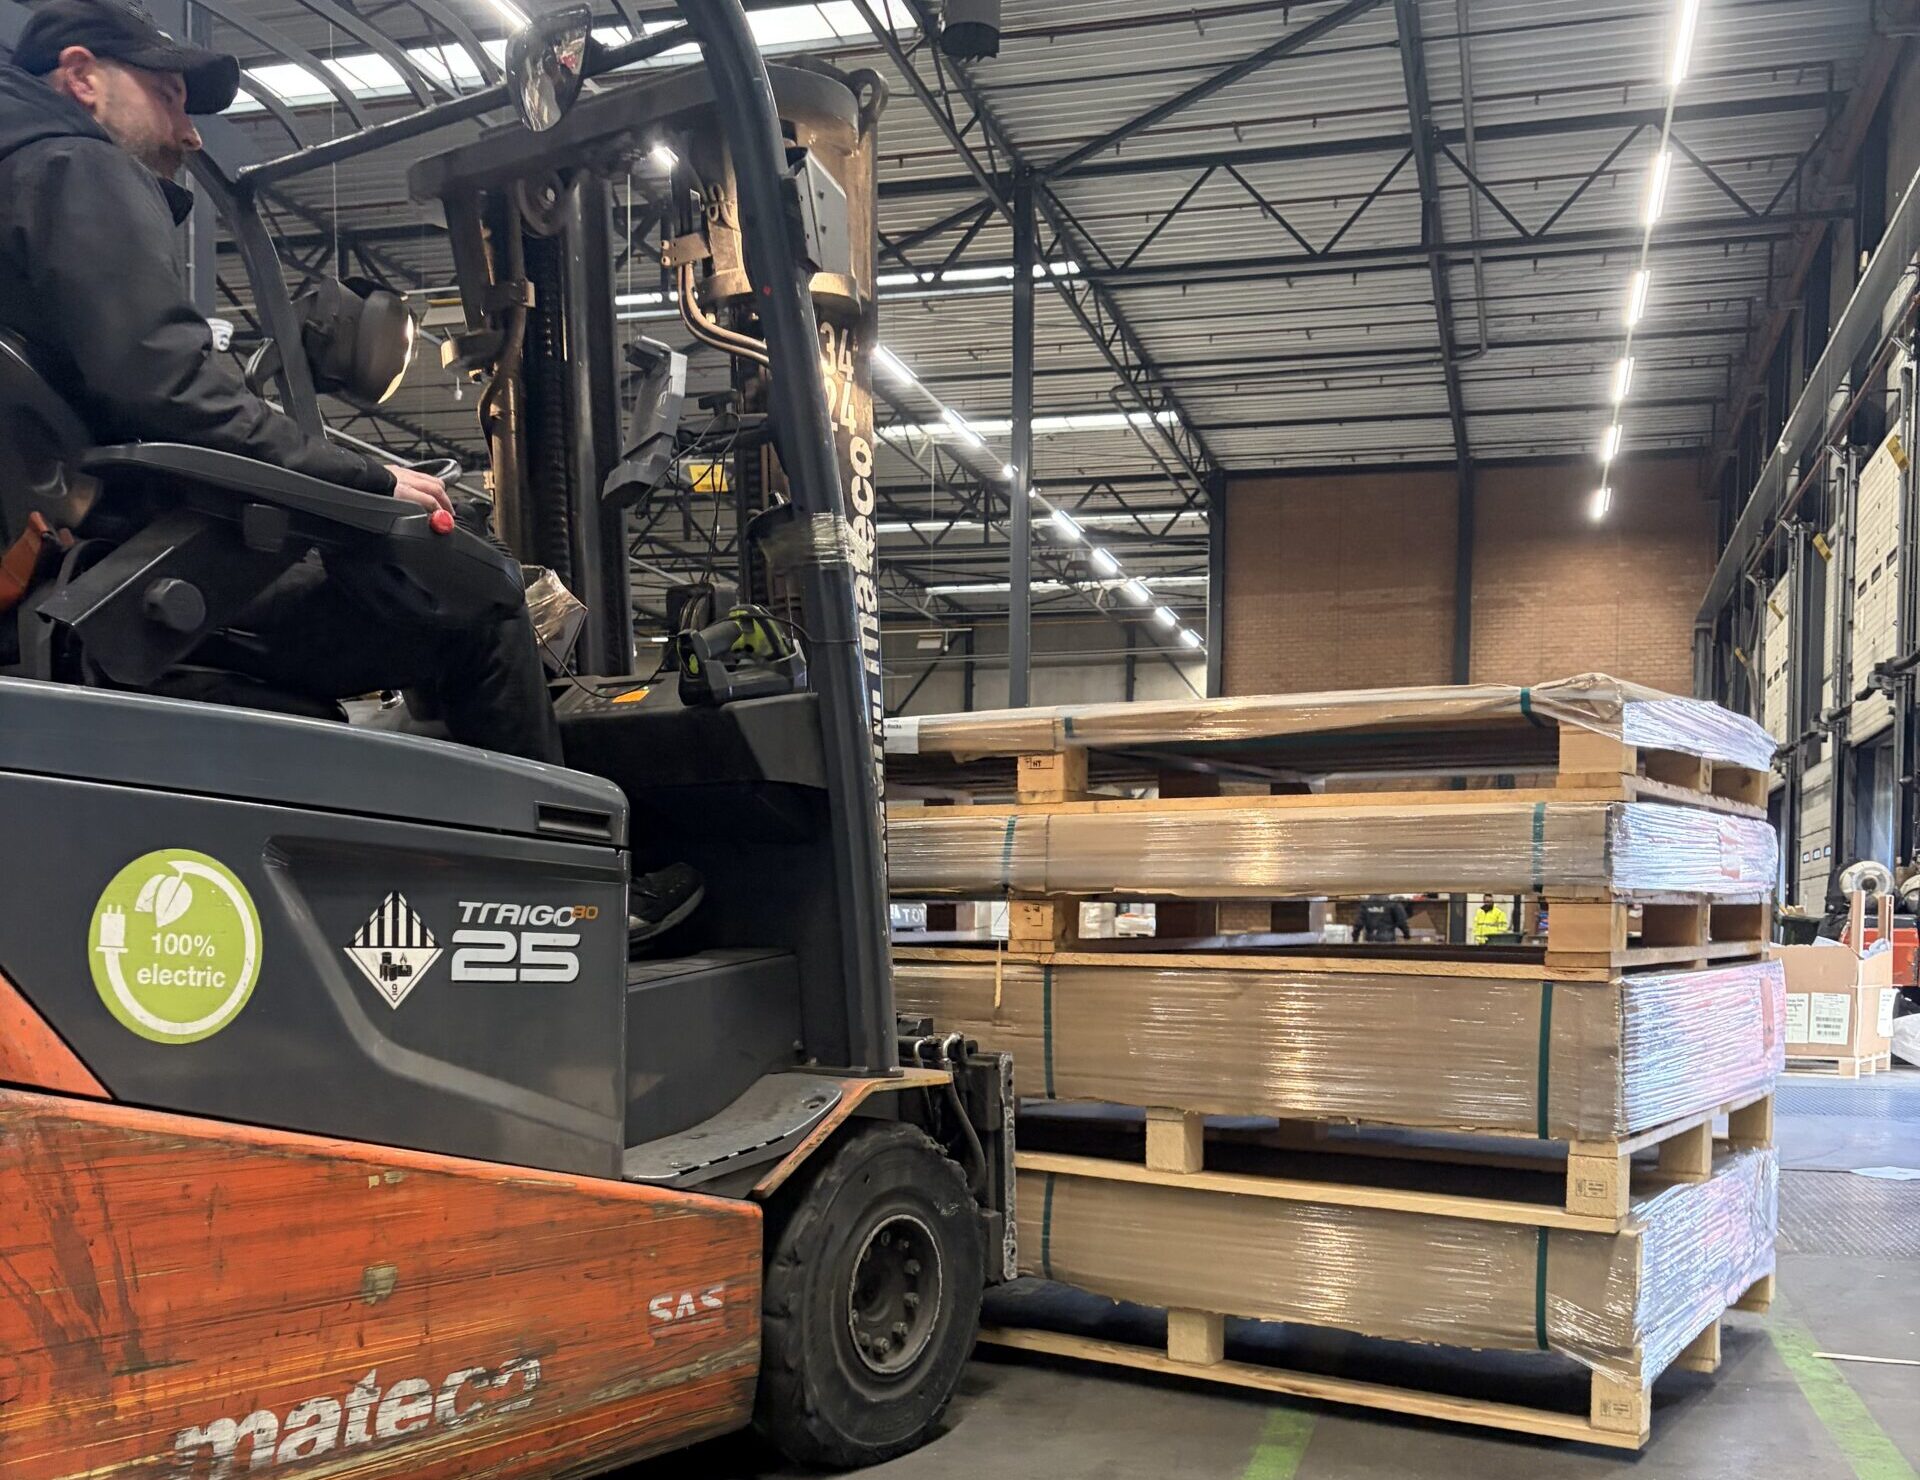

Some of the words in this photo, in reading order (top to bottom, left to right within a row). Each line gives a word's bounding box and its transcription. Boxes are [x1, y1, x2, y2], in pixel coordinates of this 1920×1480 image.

[819, 321, 855, 382] 34
[151, 932, 216, 957] 100%
[451, 929, 581, 983] 25
[136, 963, 227, 988] electric
[648, 1284, 724, 1321] SAS
[172, 1357, 541, 1480] mateco
